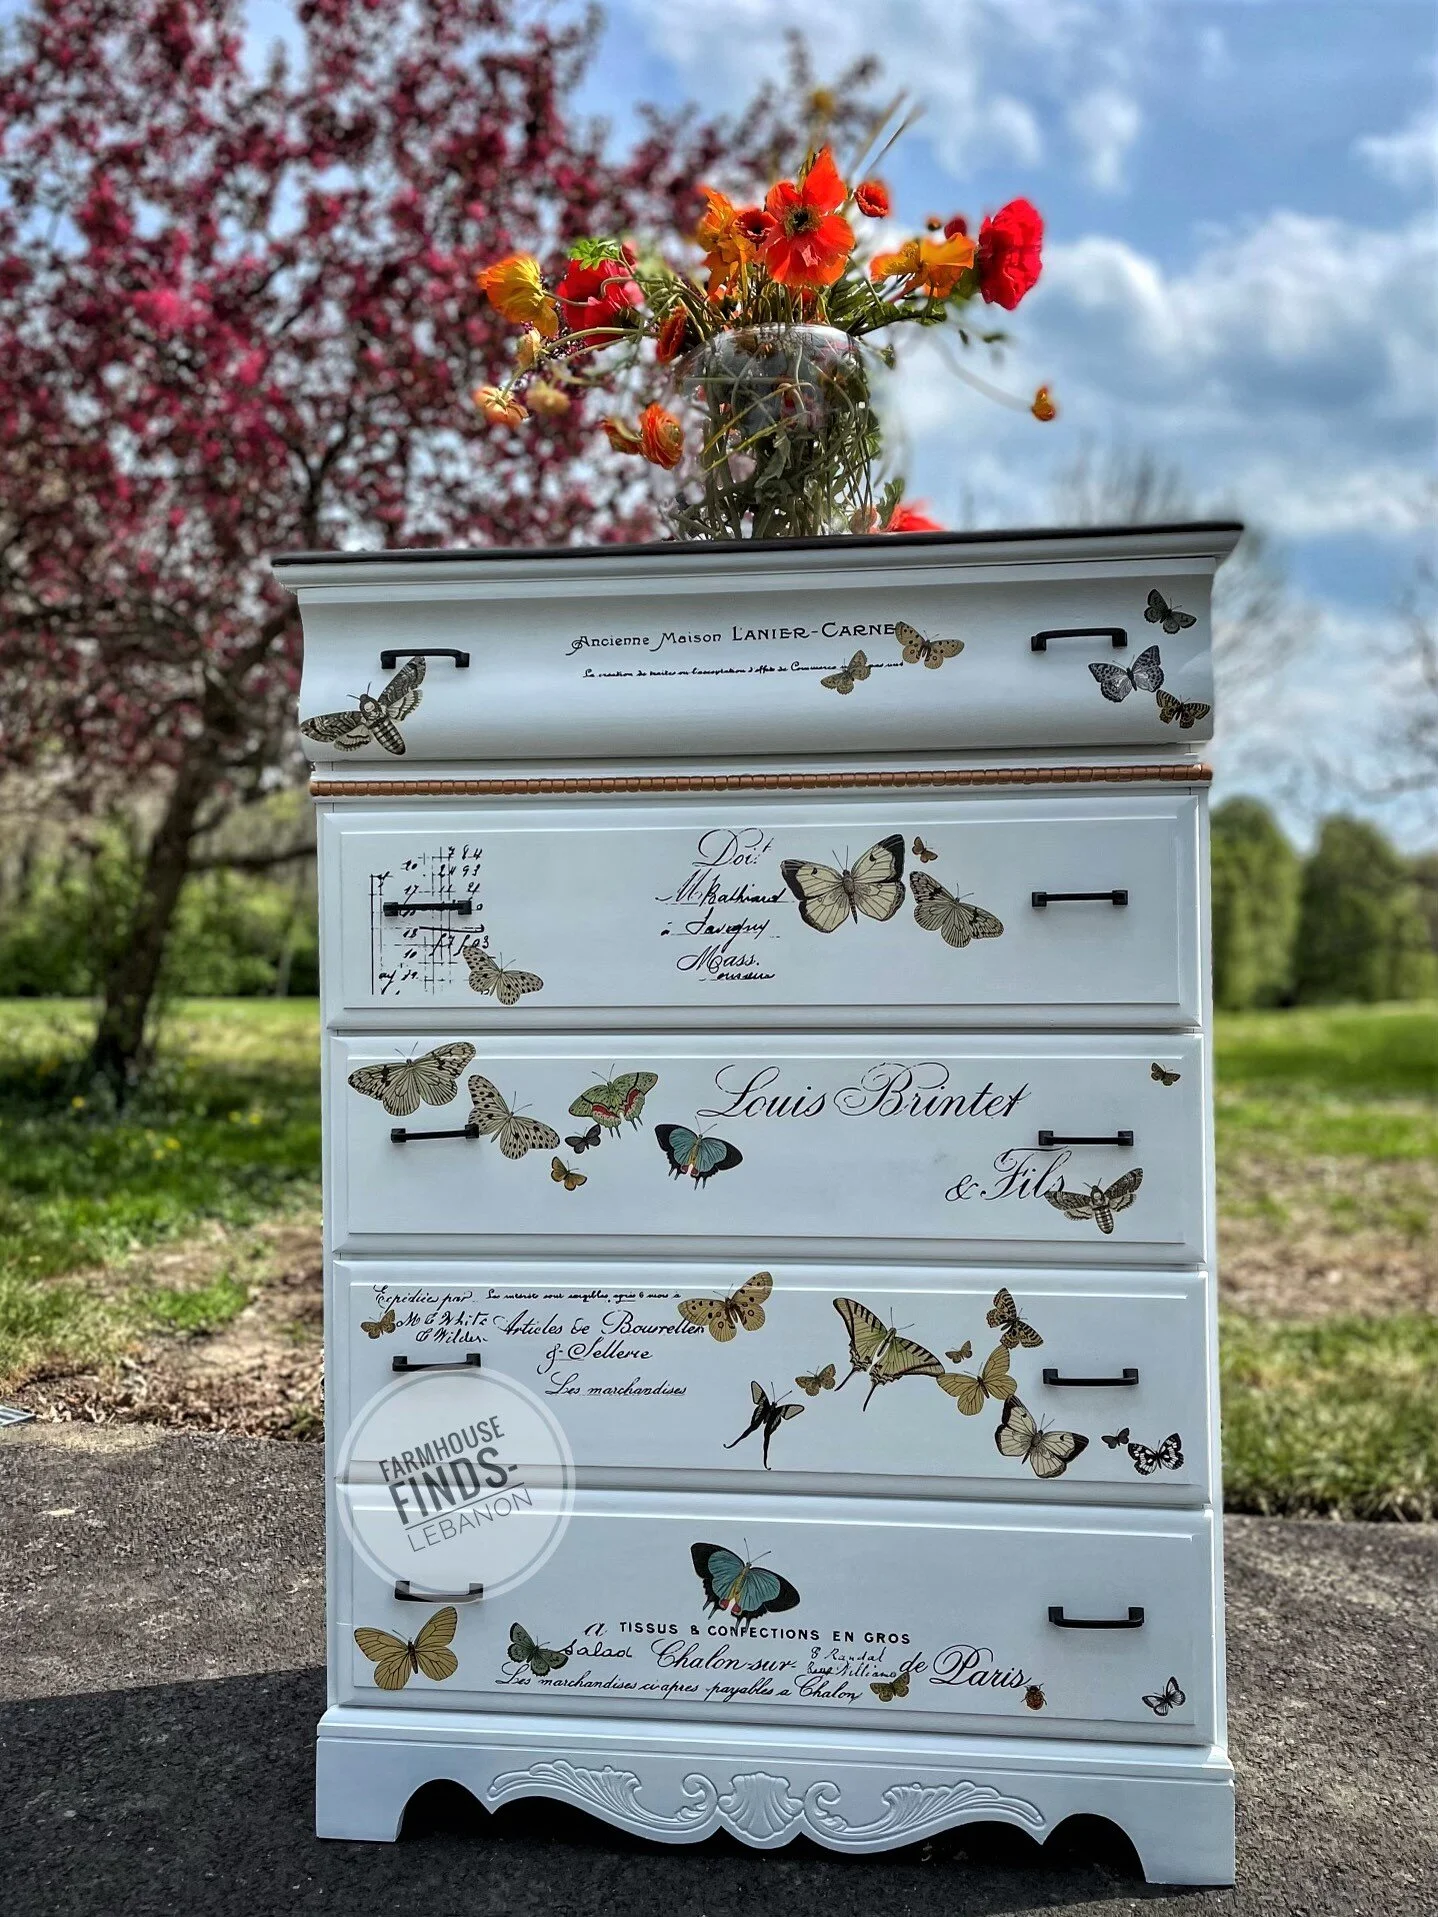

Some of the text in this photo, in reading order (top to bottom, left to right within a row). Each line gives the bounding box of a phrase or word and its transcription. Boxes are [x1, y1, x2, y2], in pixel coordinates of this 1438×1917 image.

[565, 635, 650, 656] Ancienne
[649, 632, 722, 652] Maison
[697, 1062, 1032, 1119] Louis Brintet
[944, 1146, 1073, 1202] & Fils
[493, 1309, 563, 1335] Articles
[544, 1371, 688, 1396] Les marchandises
[619, 1621, 911, 1645] TISSUS & CONFECTIONS EN GROS
[495, 1661, 532, 1685] Les
[538, 1670, 638, 1691] marchandises
[899, 1643, 1034, 1689] de Paris
